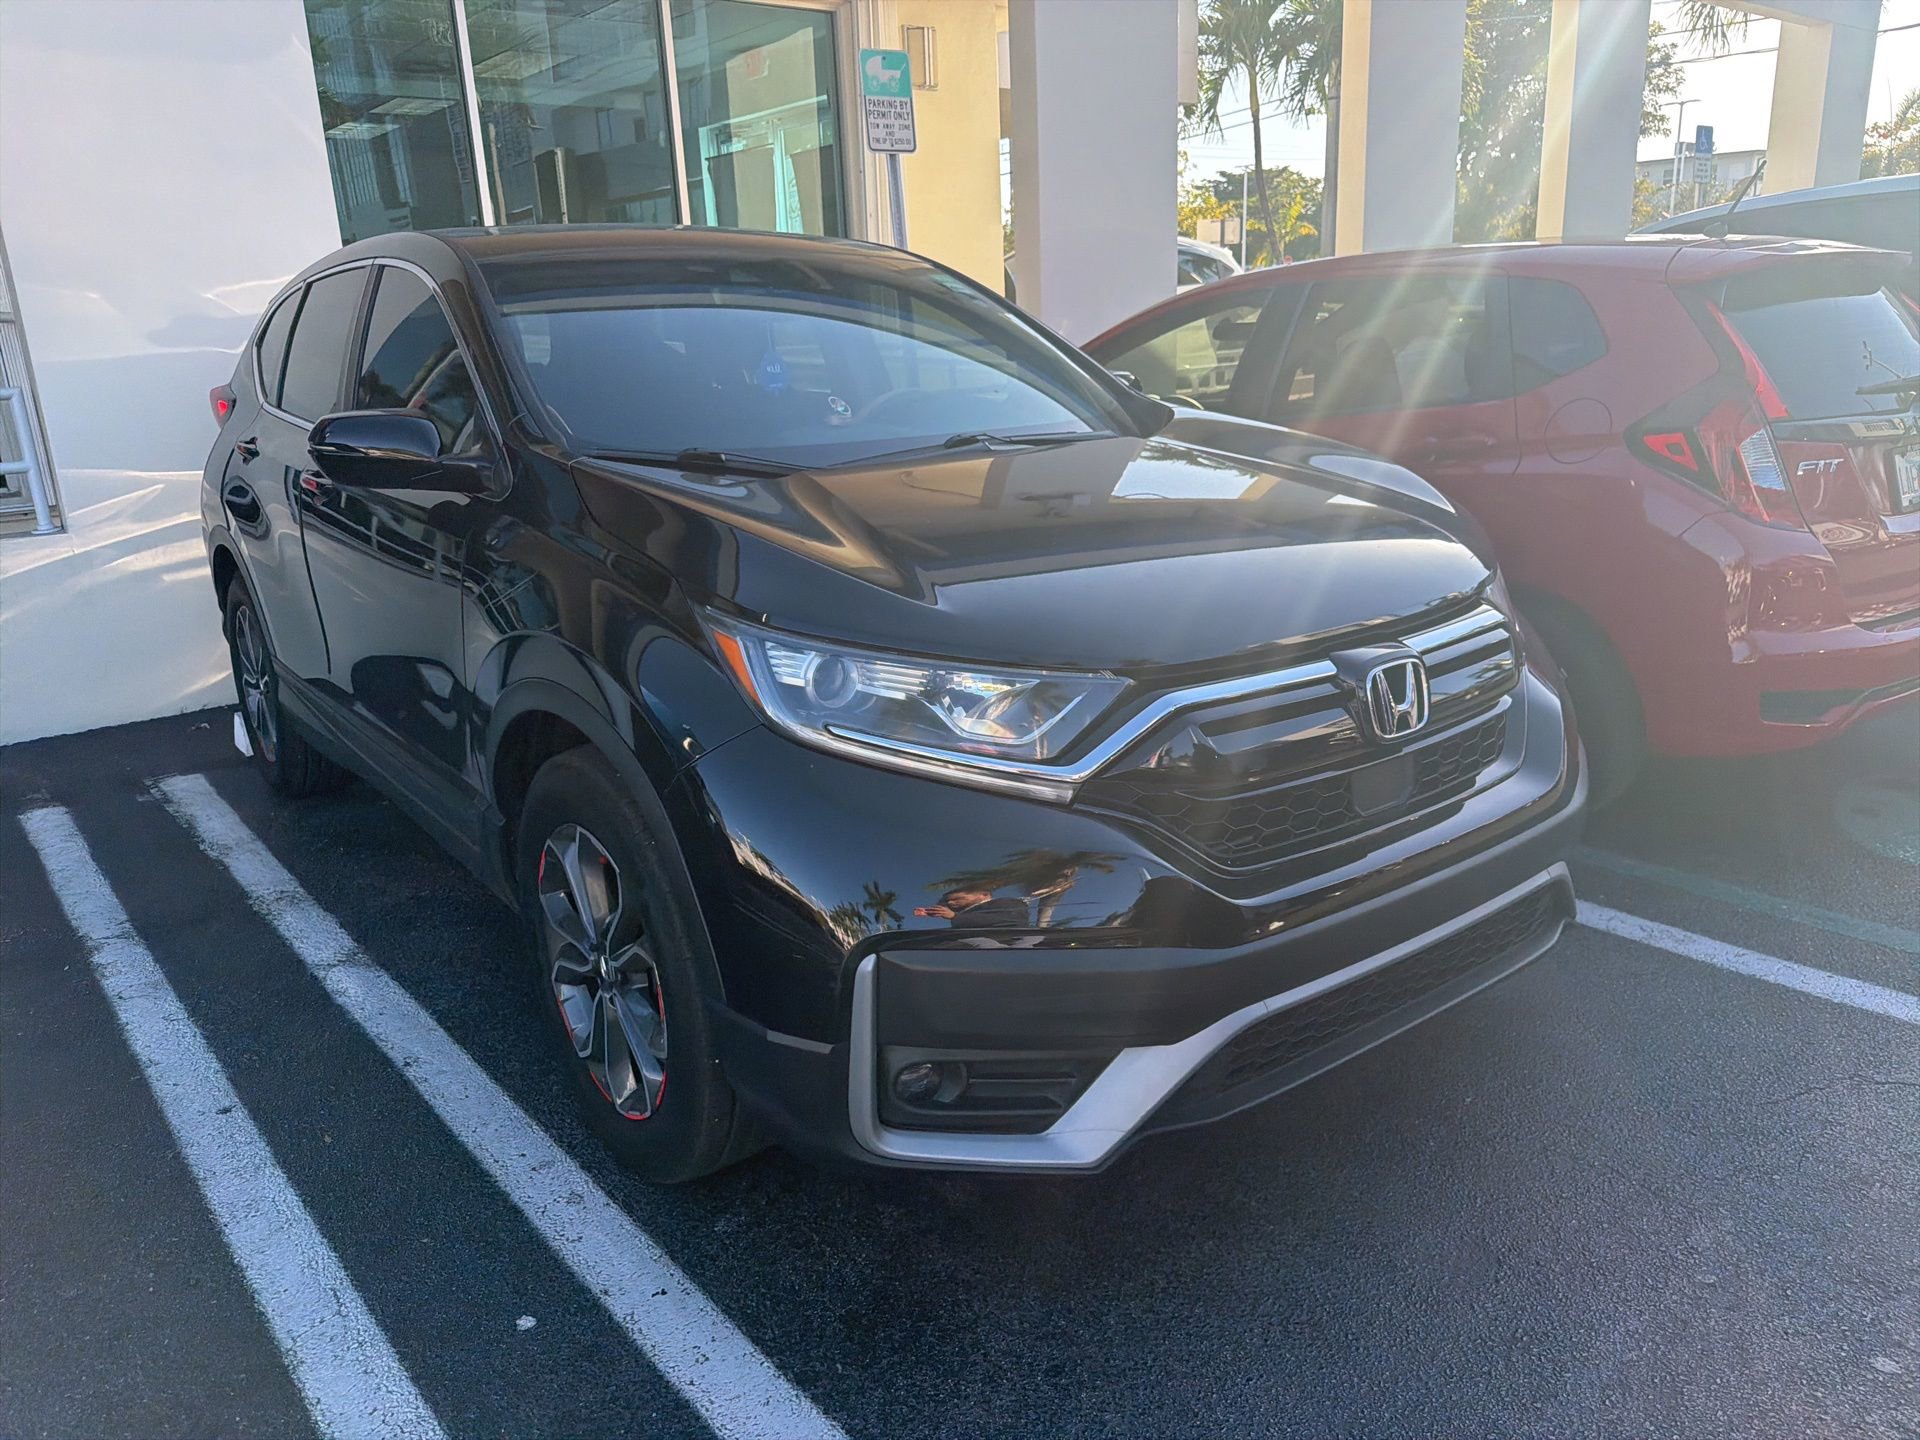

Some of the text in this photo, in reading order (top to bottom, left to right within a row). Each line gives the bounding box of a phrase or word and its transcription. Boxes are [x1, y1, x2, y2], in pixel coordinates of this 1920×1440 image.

[868, 98, 908, 110] PARKING BY
[868, 109, 910, 121] PERMIT ONLY
[1796, 458, 1845, 476] FIT
